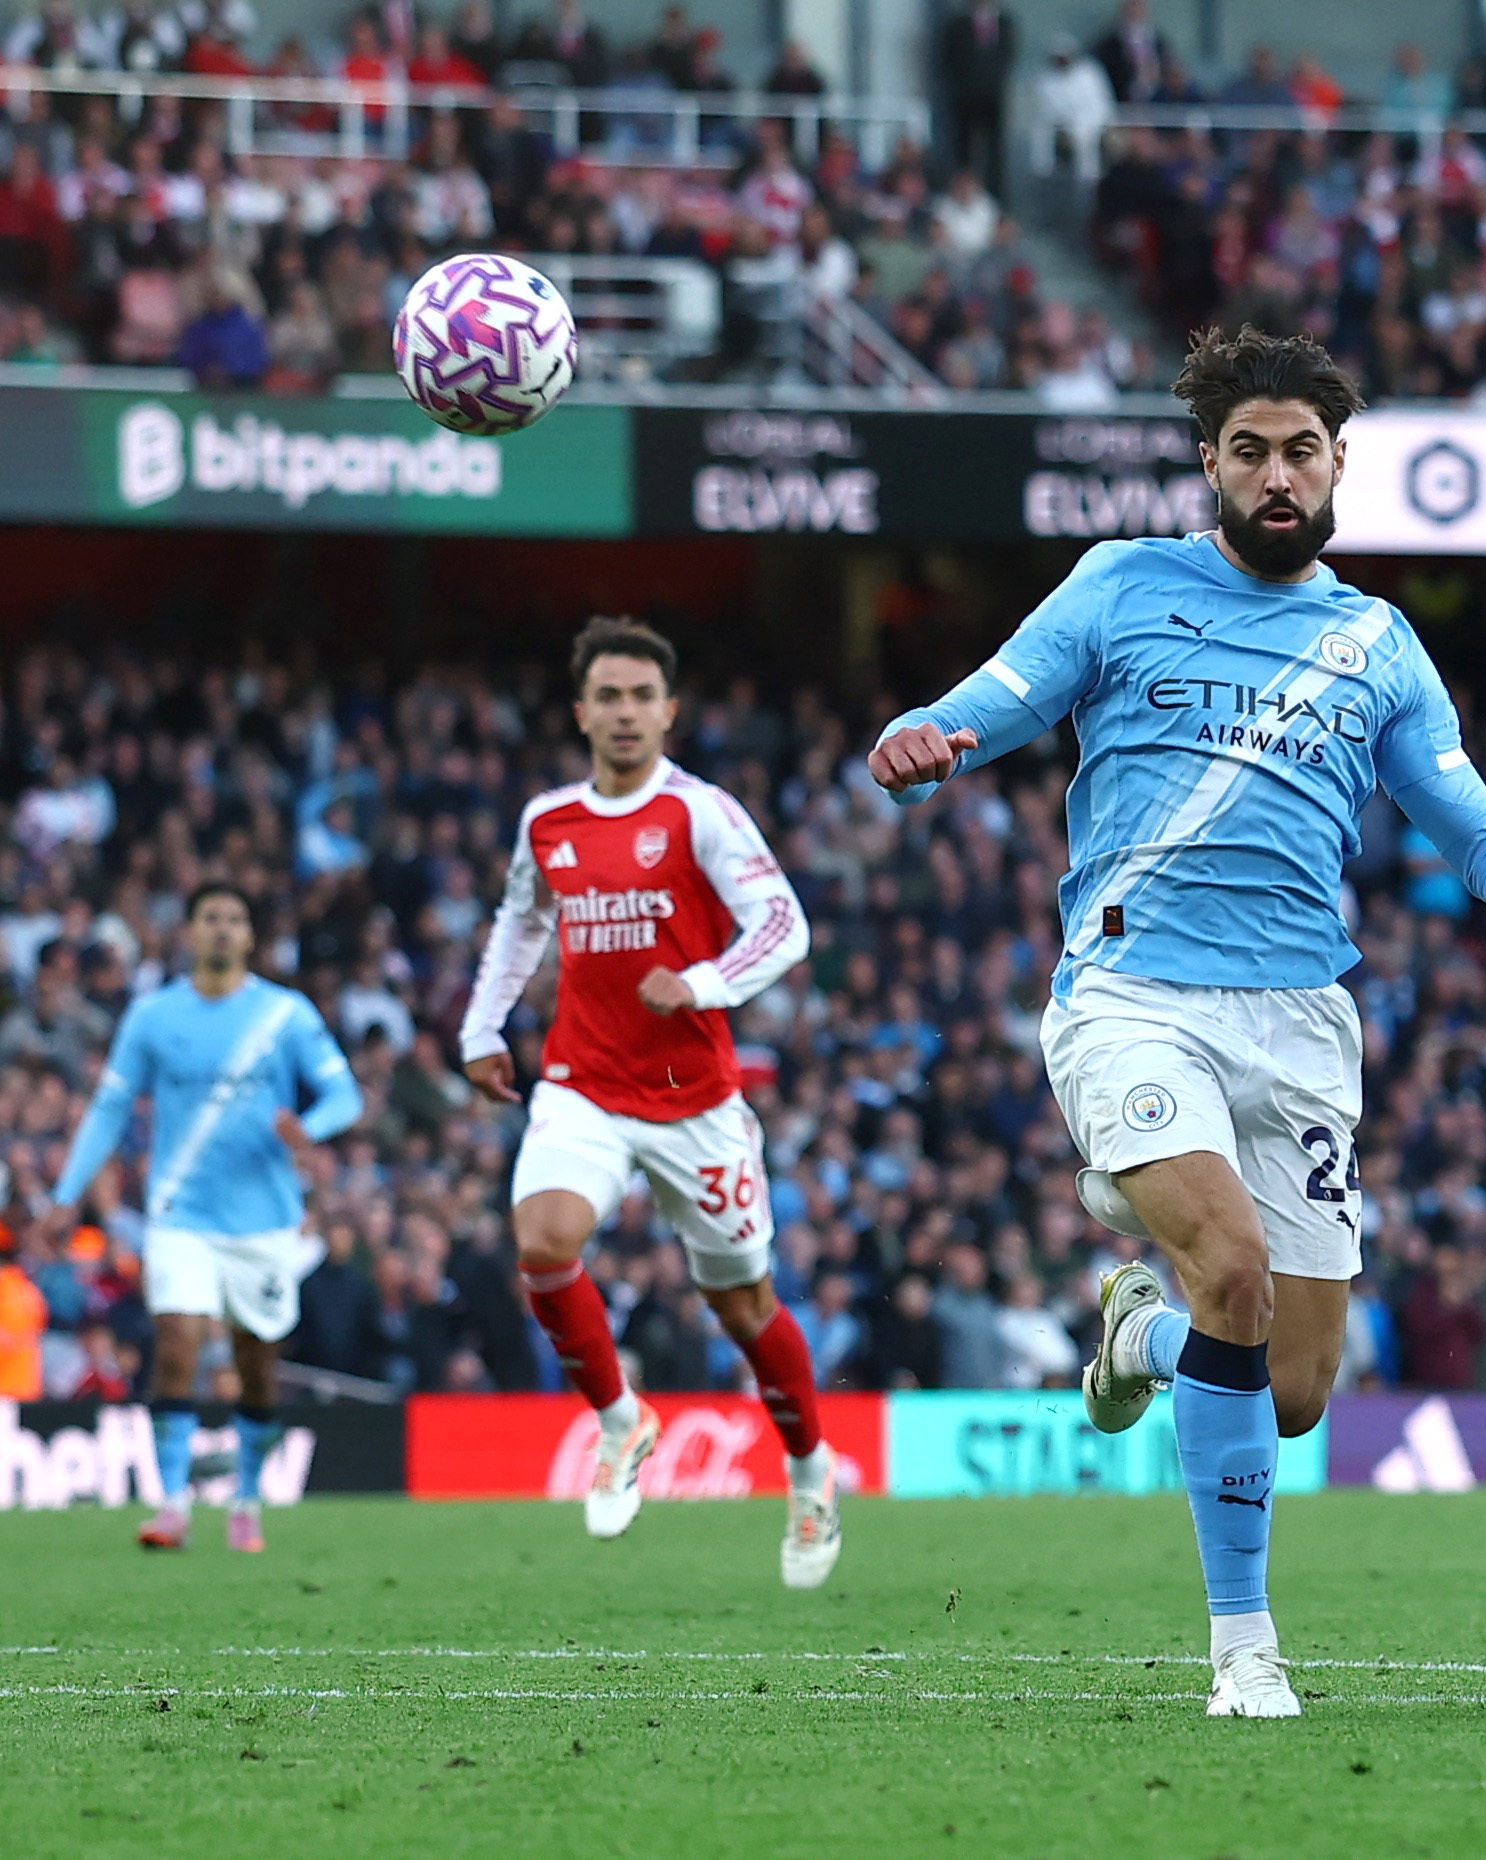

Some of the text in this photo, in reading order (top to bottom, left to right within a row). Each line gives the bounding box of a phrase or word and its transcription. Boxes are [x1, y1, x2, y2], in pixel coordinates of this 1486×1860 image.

[193, 413, 500, 506] bitpanda
[692, 465, 880, 534] ELVIVE
[1147, 678, 1368, 744] ETIHAD
[1196, 722, 1325, 764] AIRWAYS
[698, 1159, 757, 1216] 36
